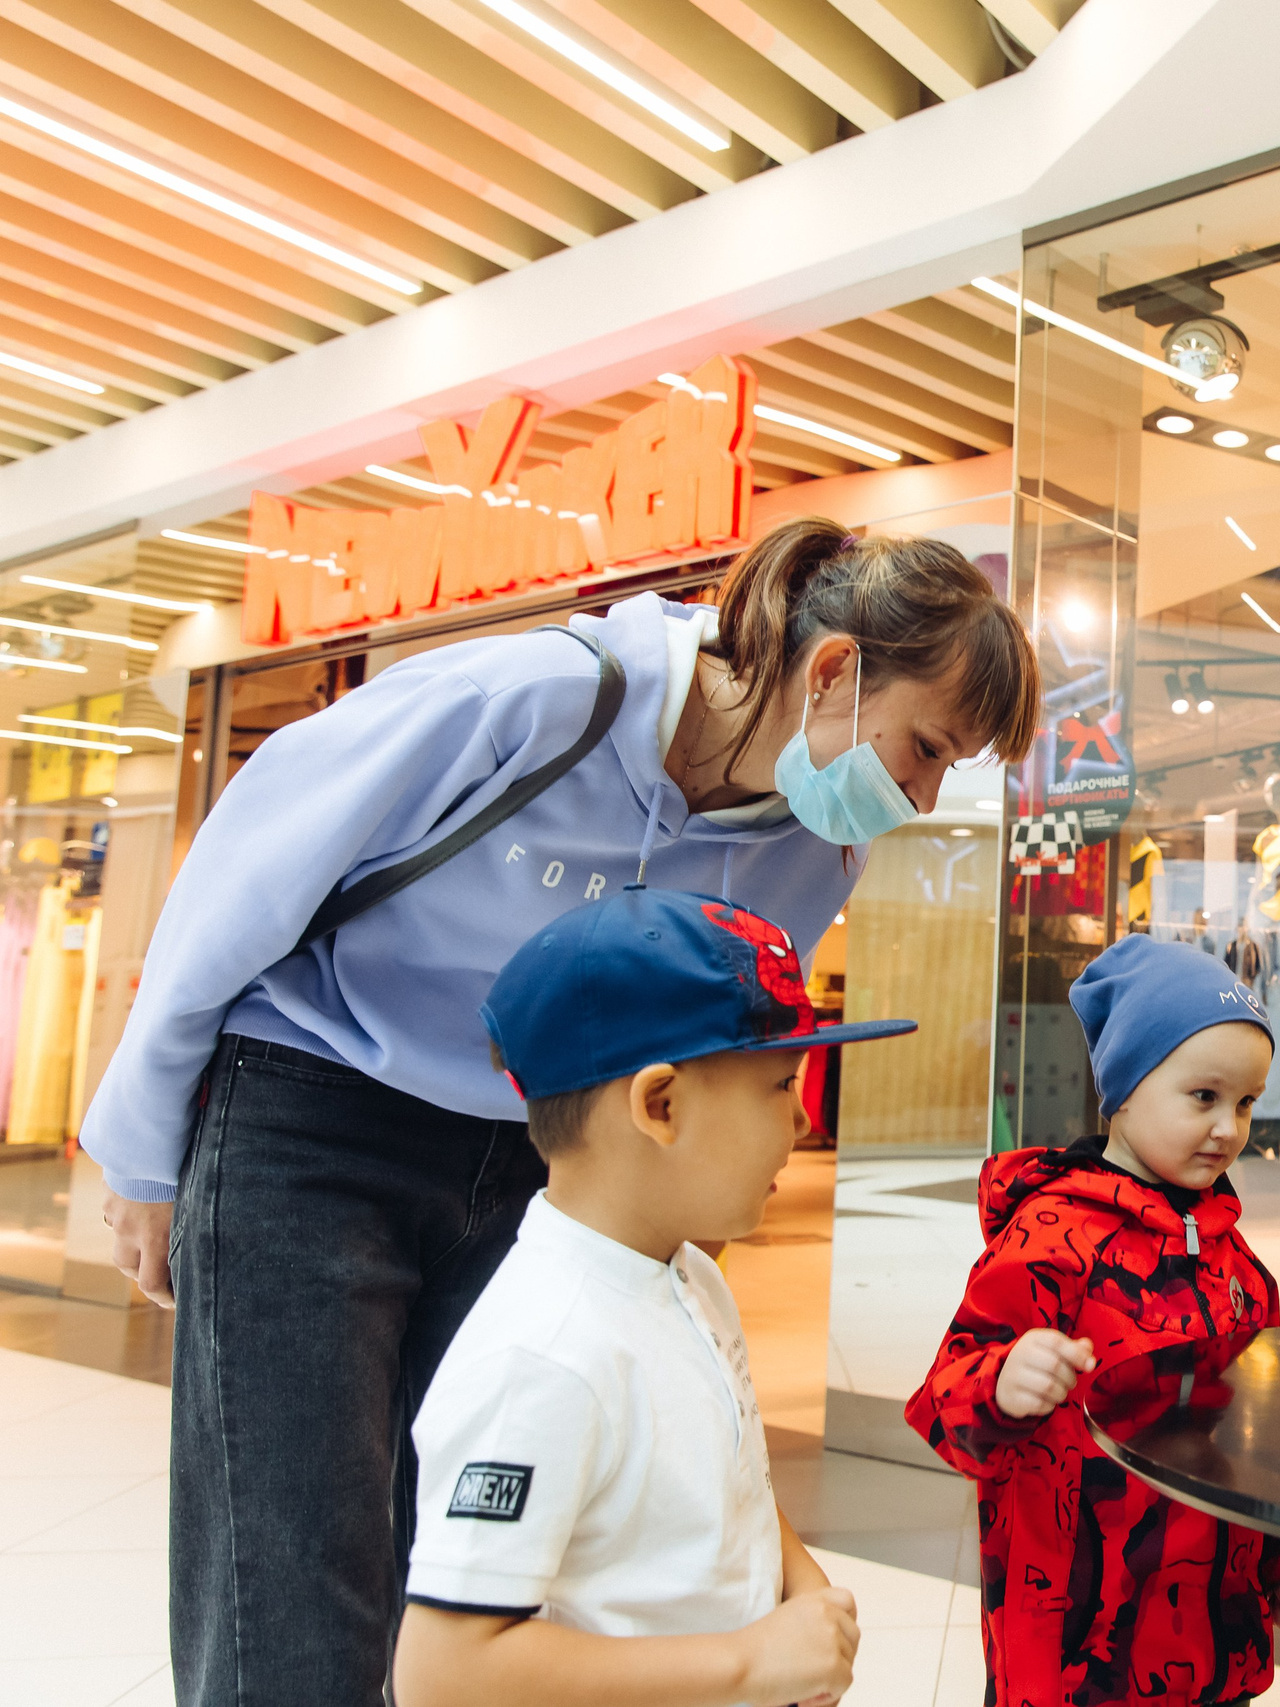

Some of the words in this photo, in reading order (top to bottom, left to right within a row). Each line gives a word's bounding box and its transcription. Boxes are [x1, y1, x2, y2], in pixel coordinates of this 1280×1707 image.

[1047, 775, 1129, 795] ПОДАРОЧНЫЕ
[505, 843, 606, 900] FOR
[452, 1473, 523, 1510] CREW
